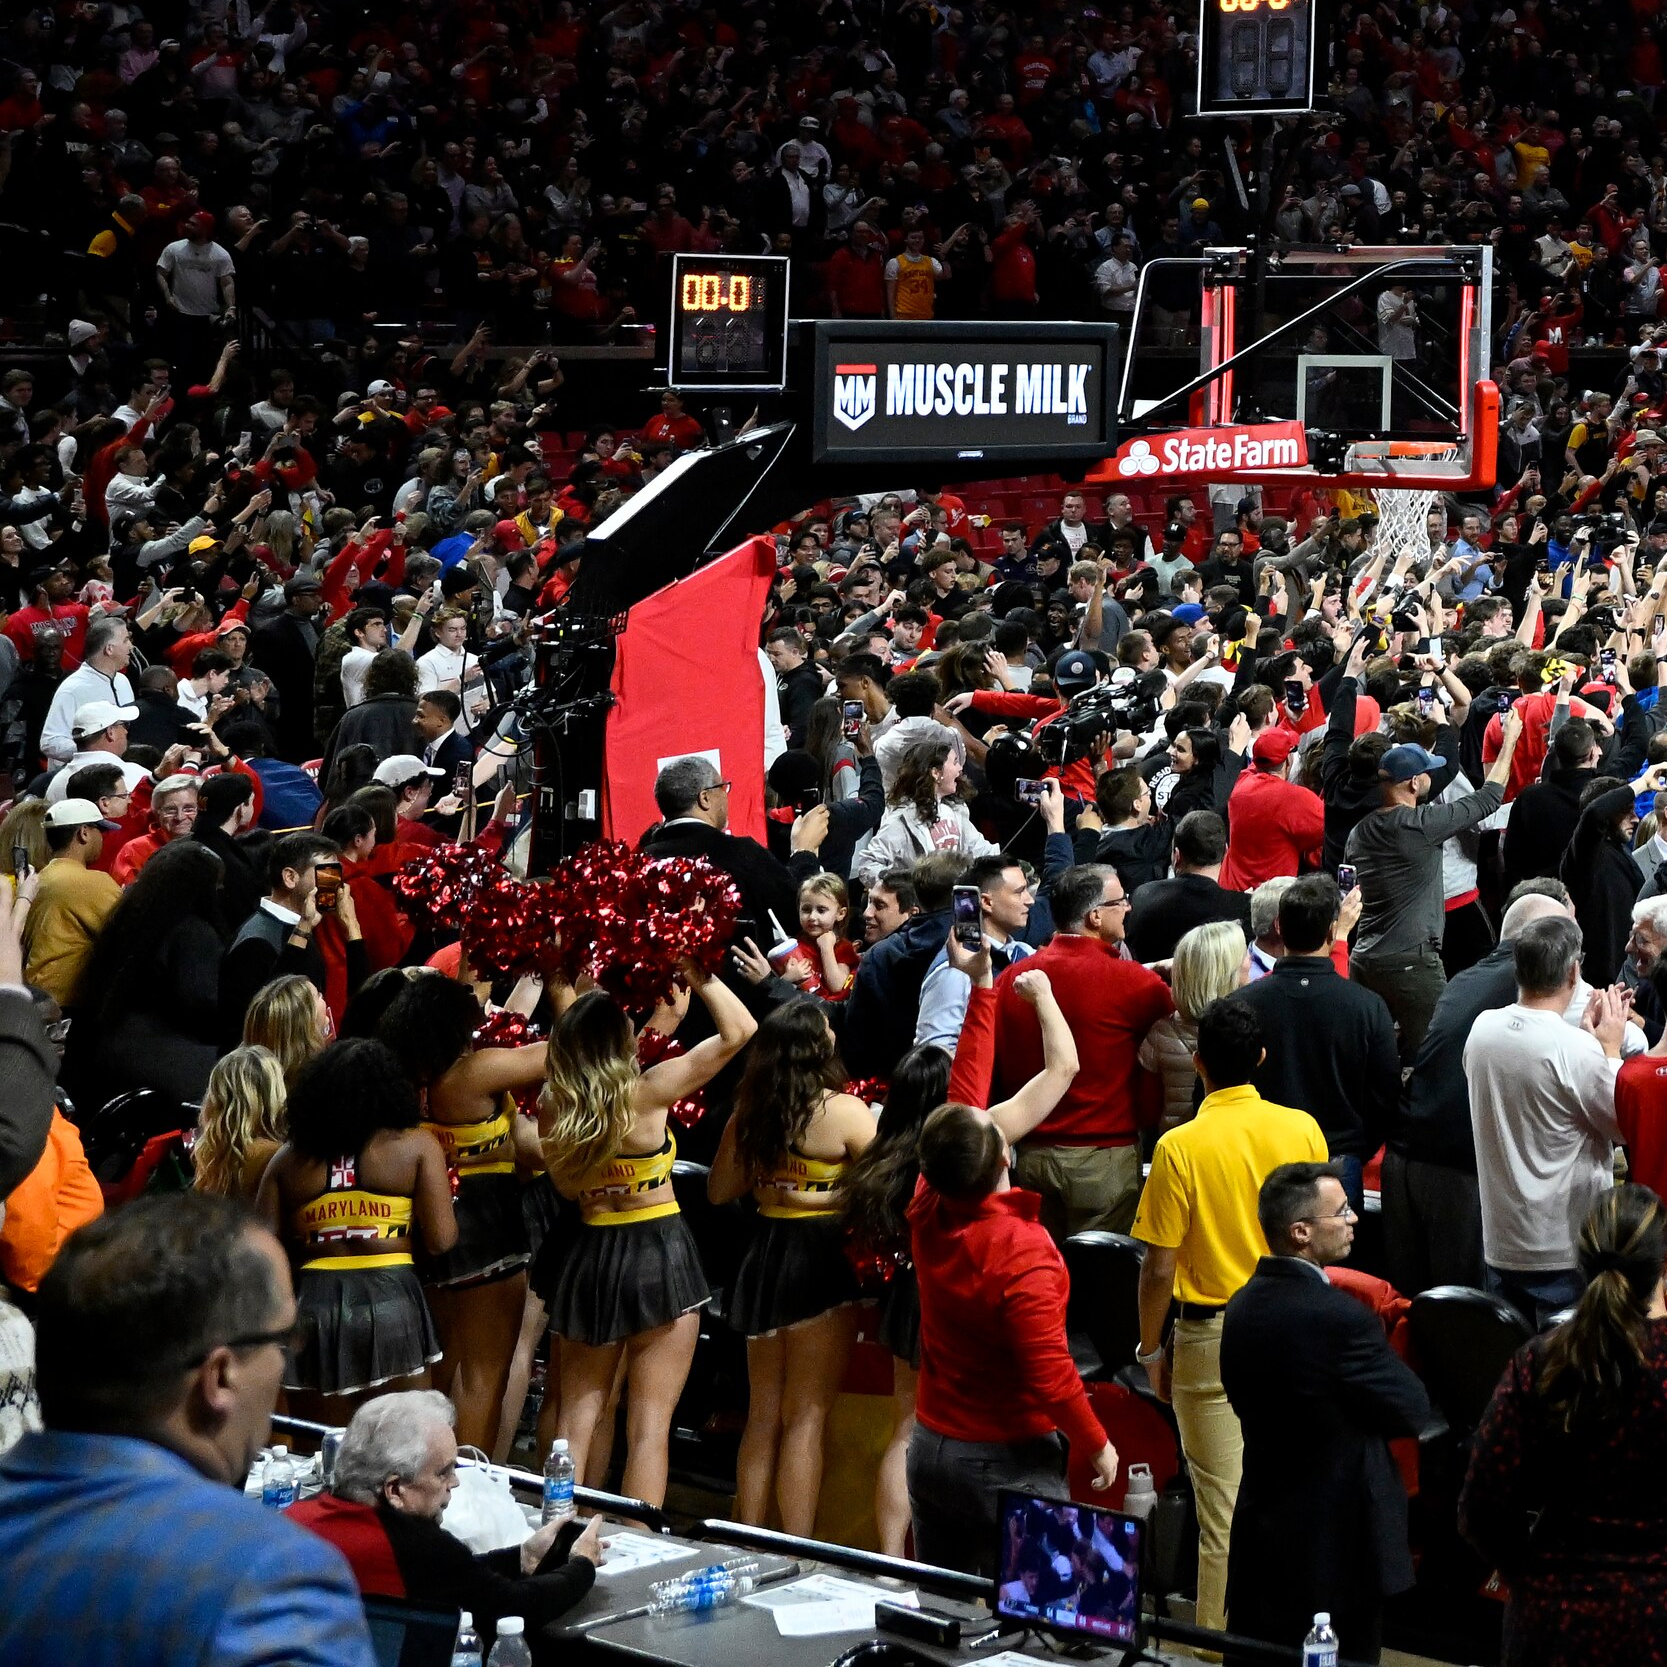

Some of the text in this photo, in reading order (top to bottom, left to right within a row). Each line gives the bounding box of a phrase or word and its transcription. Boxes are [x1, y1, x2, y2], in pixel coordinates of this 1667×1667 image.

[682, 274, 749, 311] 00.0
[886, 363, 1087, 416] MUSCLE MILK
[1068, 414, 1087, 425] BRAND
[1162, 434, 1298, 472] State Farm
[304, 1200, 392, 1224] MARYLAND
